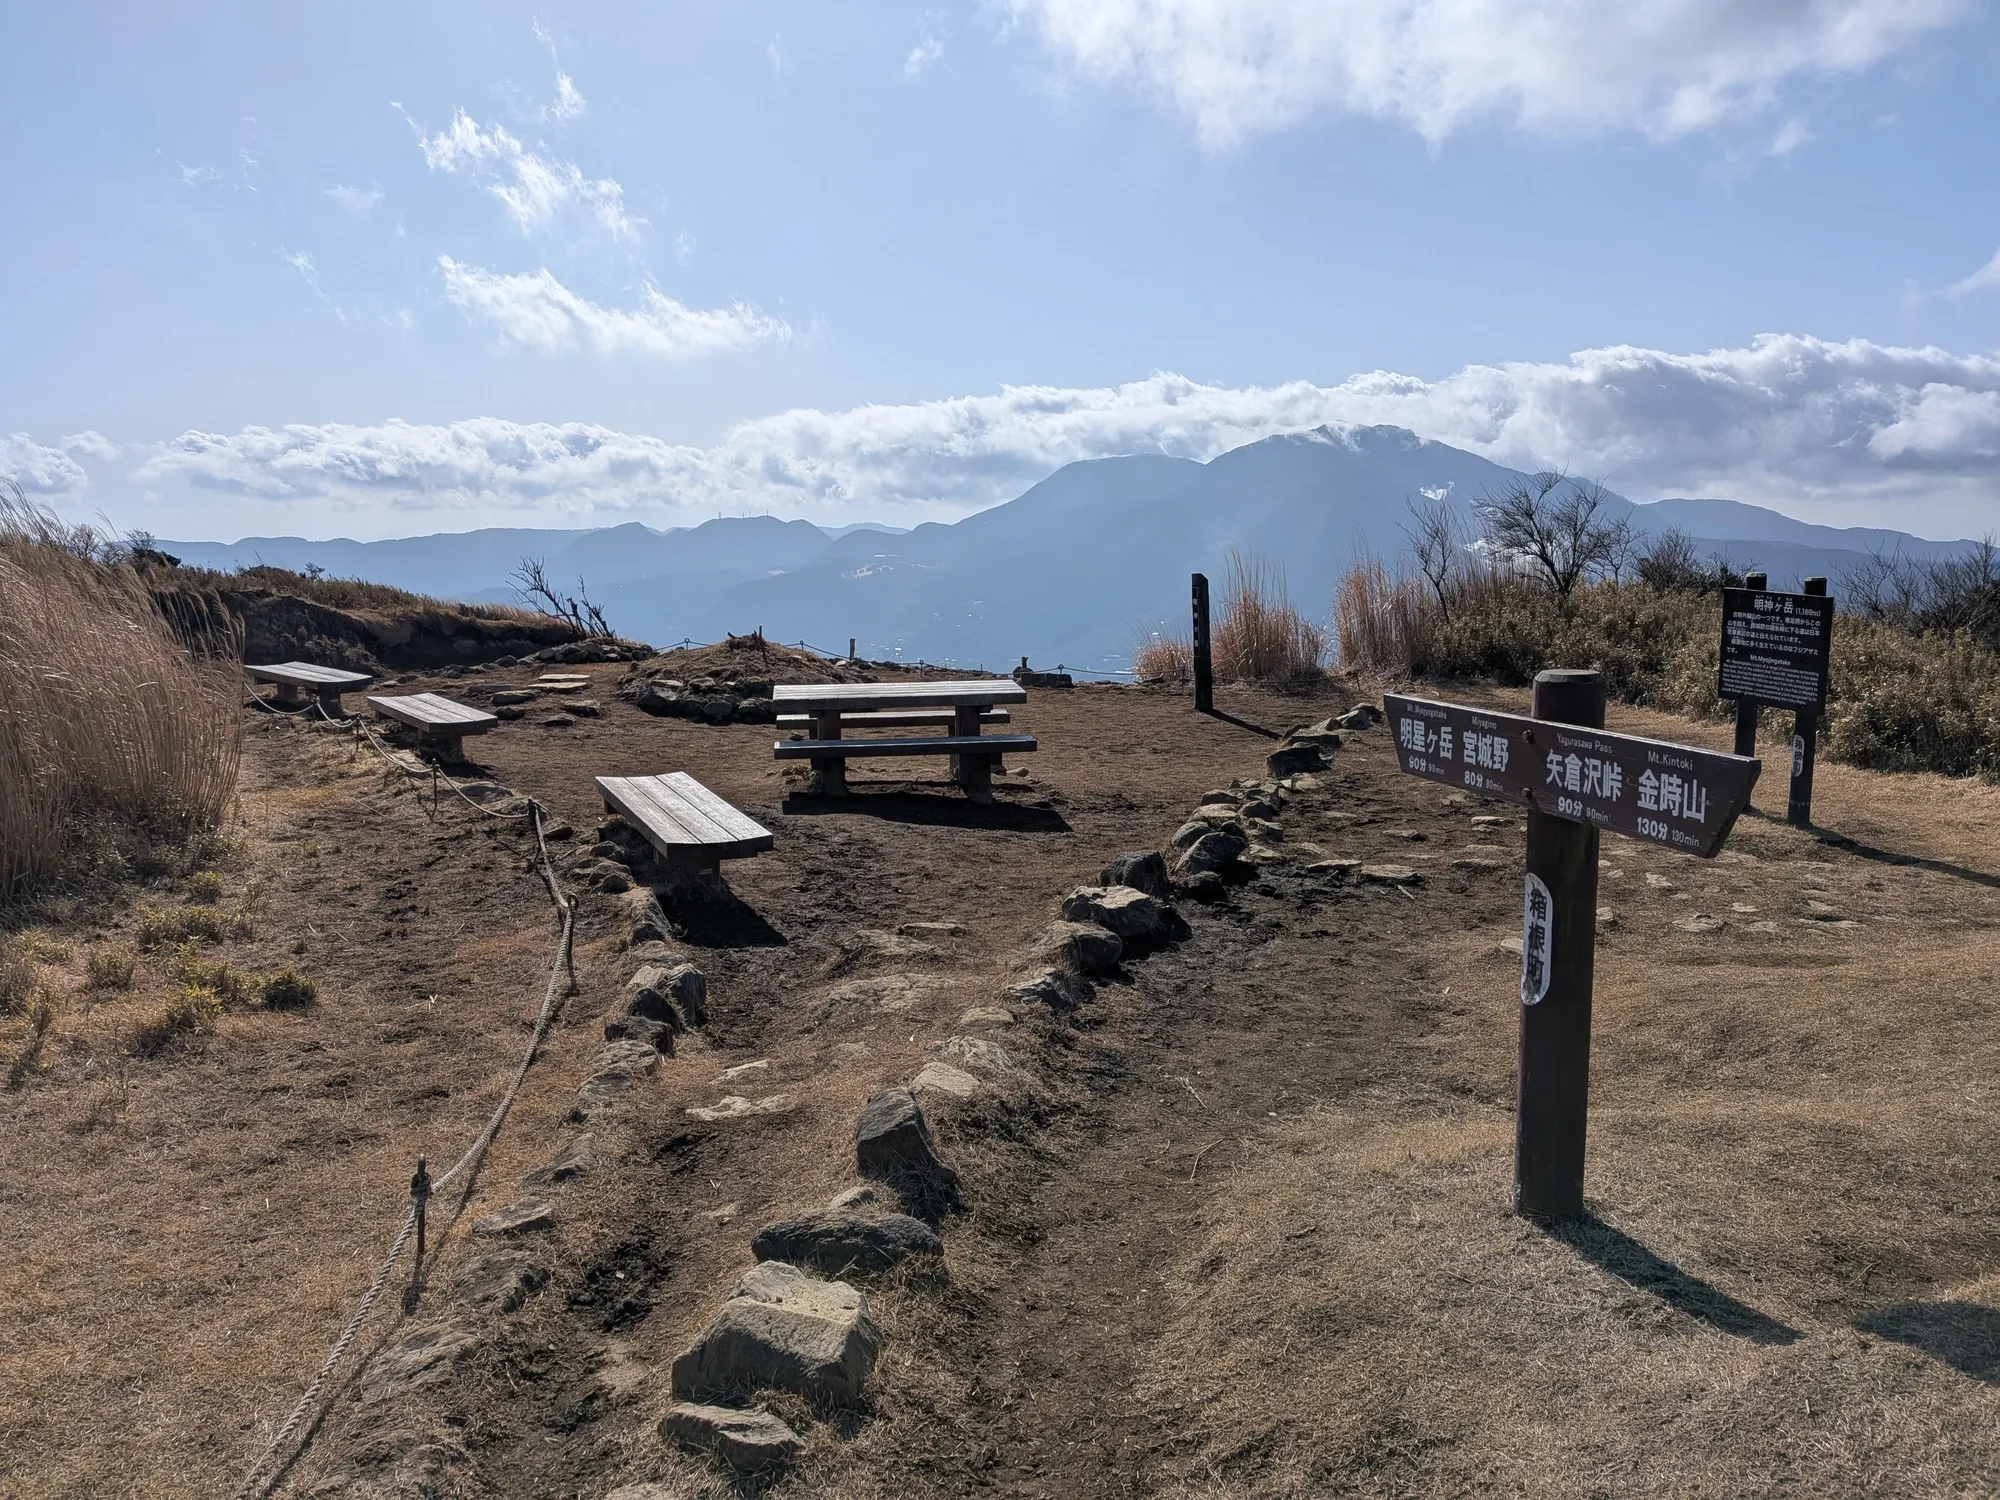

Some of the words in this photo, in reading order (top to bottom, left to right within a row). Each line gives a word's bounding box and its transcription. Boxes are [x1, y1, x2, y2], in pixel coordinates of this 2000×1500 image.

[1471, 716, 1498, 730] Miyagino
[1462, 730, 1509, 773] 宮城野
[1556, 733, 1593, 750] Yagurasawa
[1594, 740, 1613, 754] Pass
[1408, 755, 1427, 772] 90分
[1647, 750, 1693, 771] Mt.Kintoki
[1464, 770, 1484, 788] 80分
[1546, 749, 1622, 802] 矢倉沢峠
[1637, 768, 1707, 824] 金時山
[1557, 796, 1583, 818] 90分
[1637, 816, 1669, 841] 130分
[1671, 829, 1700, 847] 130min
